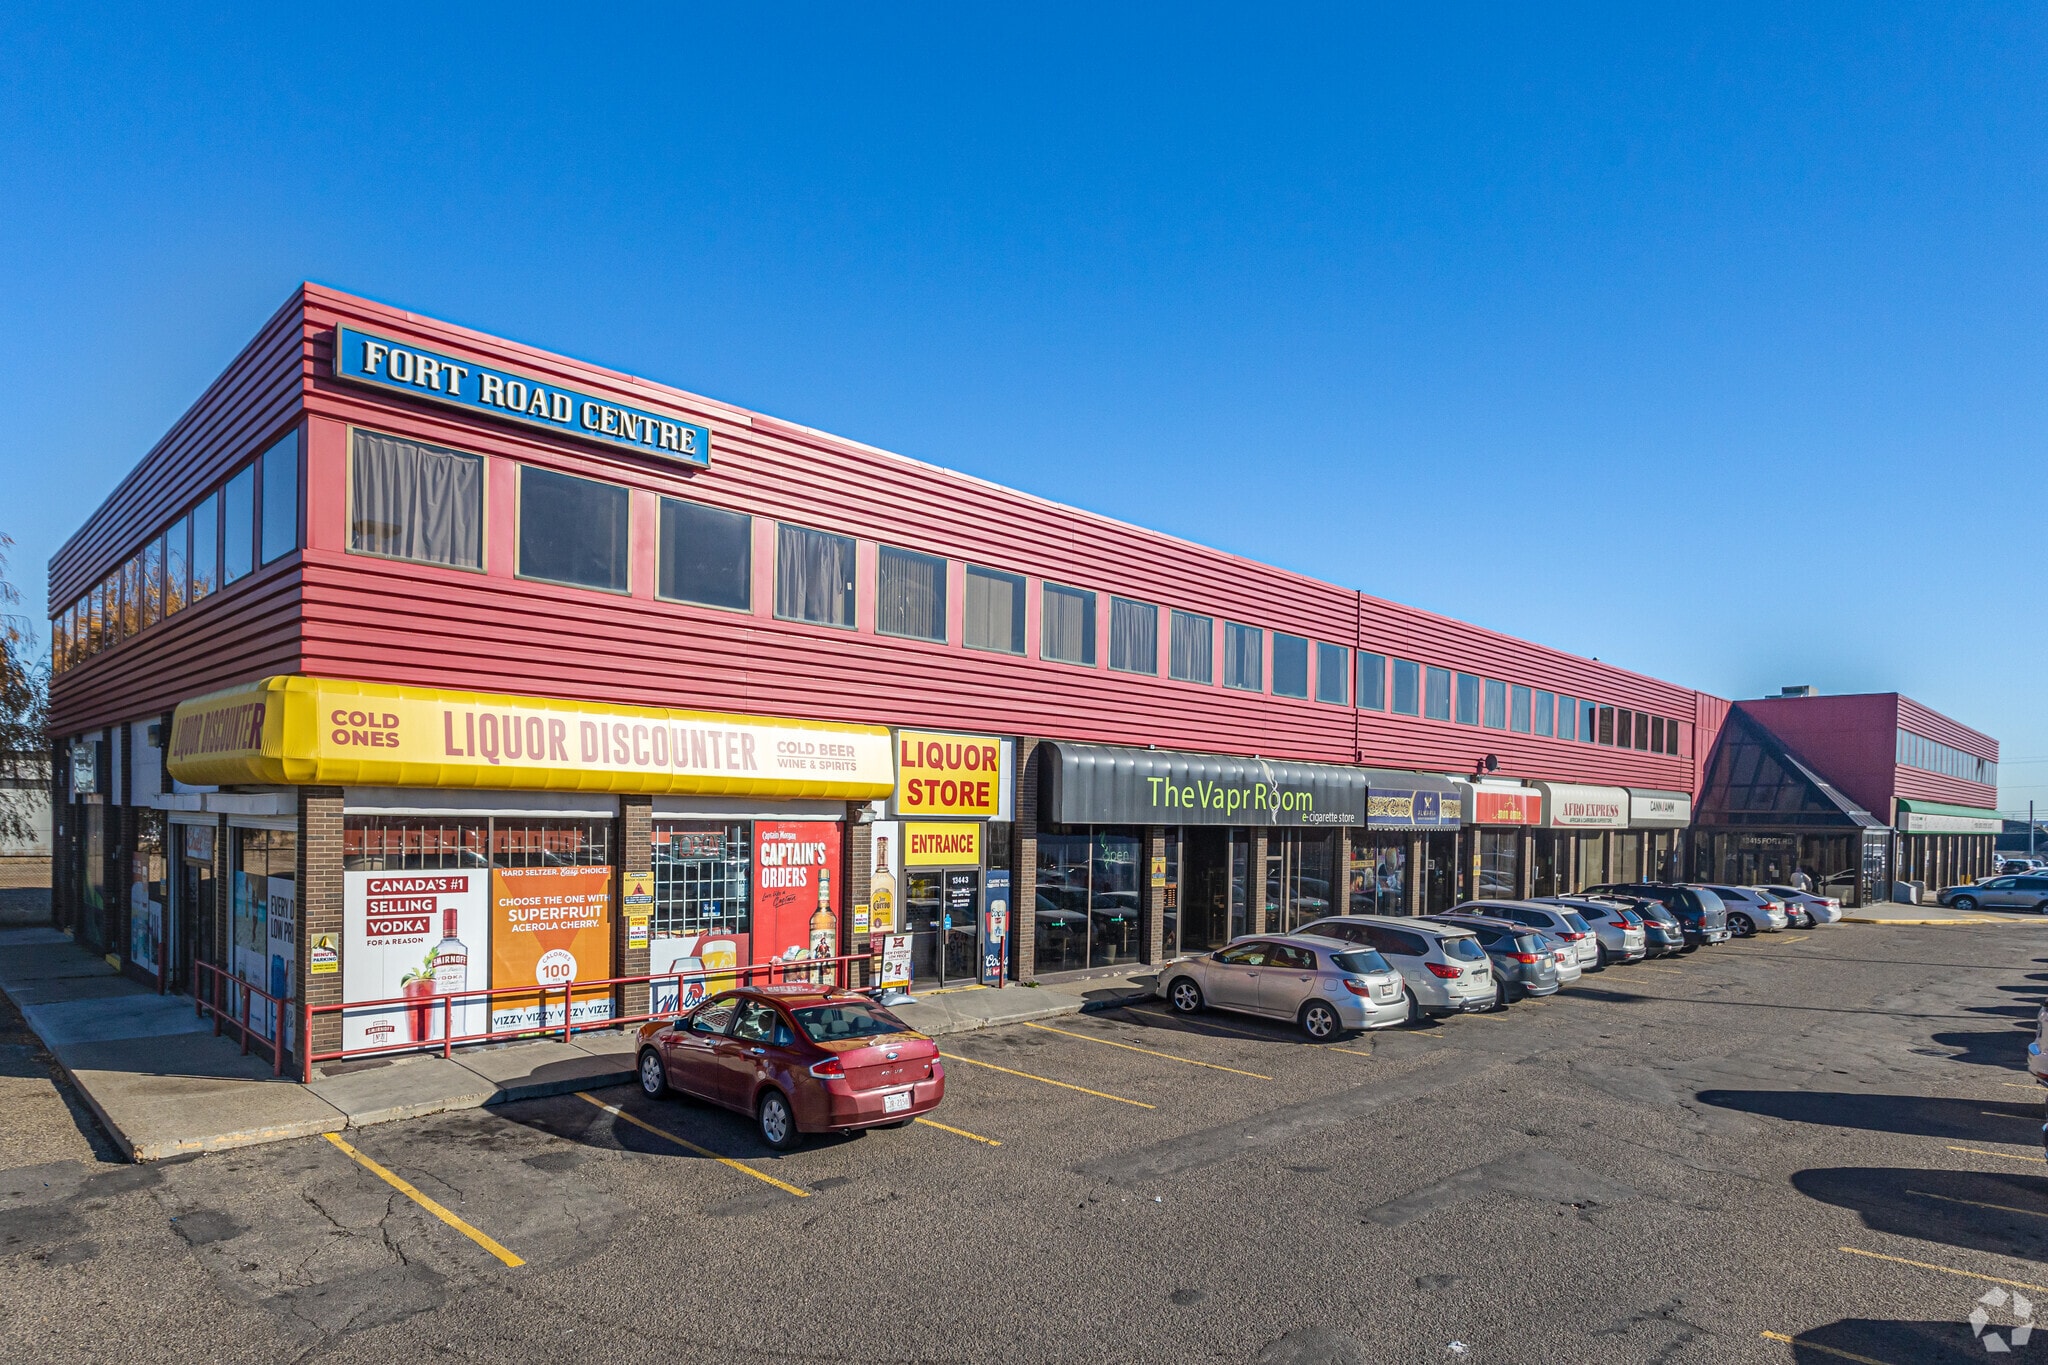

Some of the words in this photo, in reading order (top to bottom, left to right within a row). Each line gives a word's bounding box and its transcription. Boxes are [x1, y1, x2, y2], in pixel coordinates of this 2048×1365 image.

[362, 340, 468, 395] FORT
[479, 373, 572, 423] ROAD
[582, 401, 697, 454] CENTRE
[331, 709, 400, 729] COLD
[173, 713, 203, 763] LIQUOR
[203, 702, 266, 754] DISCOUNTER
[331, 728, 400, 749] ONES
[443, 710, 569, 765] LIQUOR
[580, 720, 758, 771] DISCOUNTER
[776, 740, 816, 757] COLD
[819, 744, 856, 758] BEER
[901, 740, 997, 772] LIQUOR
[776, 758, 807, 771] WINE
[809, 760, 817, 771] &
[819, 760, 858, 772] SPIRITS
[907, 778, 990, 807] STORE
[1147, 776, 1195, 809] The
[1198, 779, 1251, 816] Vapr
[1255, 783, 1313, 812] Room
[1301, 811, 1338, 825] e-cigarette
[1338, 813, 1355, 823] store
[1562, 802, 1585, 817] AFRO
[1586, 803, 1620, 818] EXPRESS
[680, 835, 720, 857] OPEN
[911, 833, 974, 854] ENTRANCE
[1762, 837, 1781, 845] FORT
[760, 842, 827, 867] CAPTAIN'S
[1102, 851, 1129, 864] open
[501, 869, 524, 877] HARD
[525, 868, 559, 876] SELTZER.
[560, 867, 579, 877] Easy
[580, 867, 609, 875] CHOICE.
[761, 867, 807, 889] ORDERS
[369, 878, 447, 893] CANADA'S
[449, 879, 465, 891] #1
[271, 895, 289, 919] EVERY
[369, 899, 433, 914] SELLING
[498, 897, 541, 907] CHOOSE
[543, 896, 562, 905] THE
[564, 895, 585, 904] ONE
[587, 894, 611, 902] WITH
[508, 905, 603, 922] SUPERFRUIT
[271, 917, 283, 940] LOW
[511, 922, 559, 933] ACEROLA
[560, 919, 600, 930] CHERRY.
[392, 937, 424, 945] REASON
[432, 955, 467, 967] SMIRNOFF
[542, 952, 571, 964] CALORIES
[985, 954, 1009, 968] Coos
[542, 963, 570, 979] 100
[588, 1003, 615, 1015] VIZZY
[656, 991, 713, 1014] Mlson
[494, 1014, 523, 1026] VIZZY
[526, 1010, 555, 1022] VIZZY
[557, 1007, 585, 1018] VZZY
